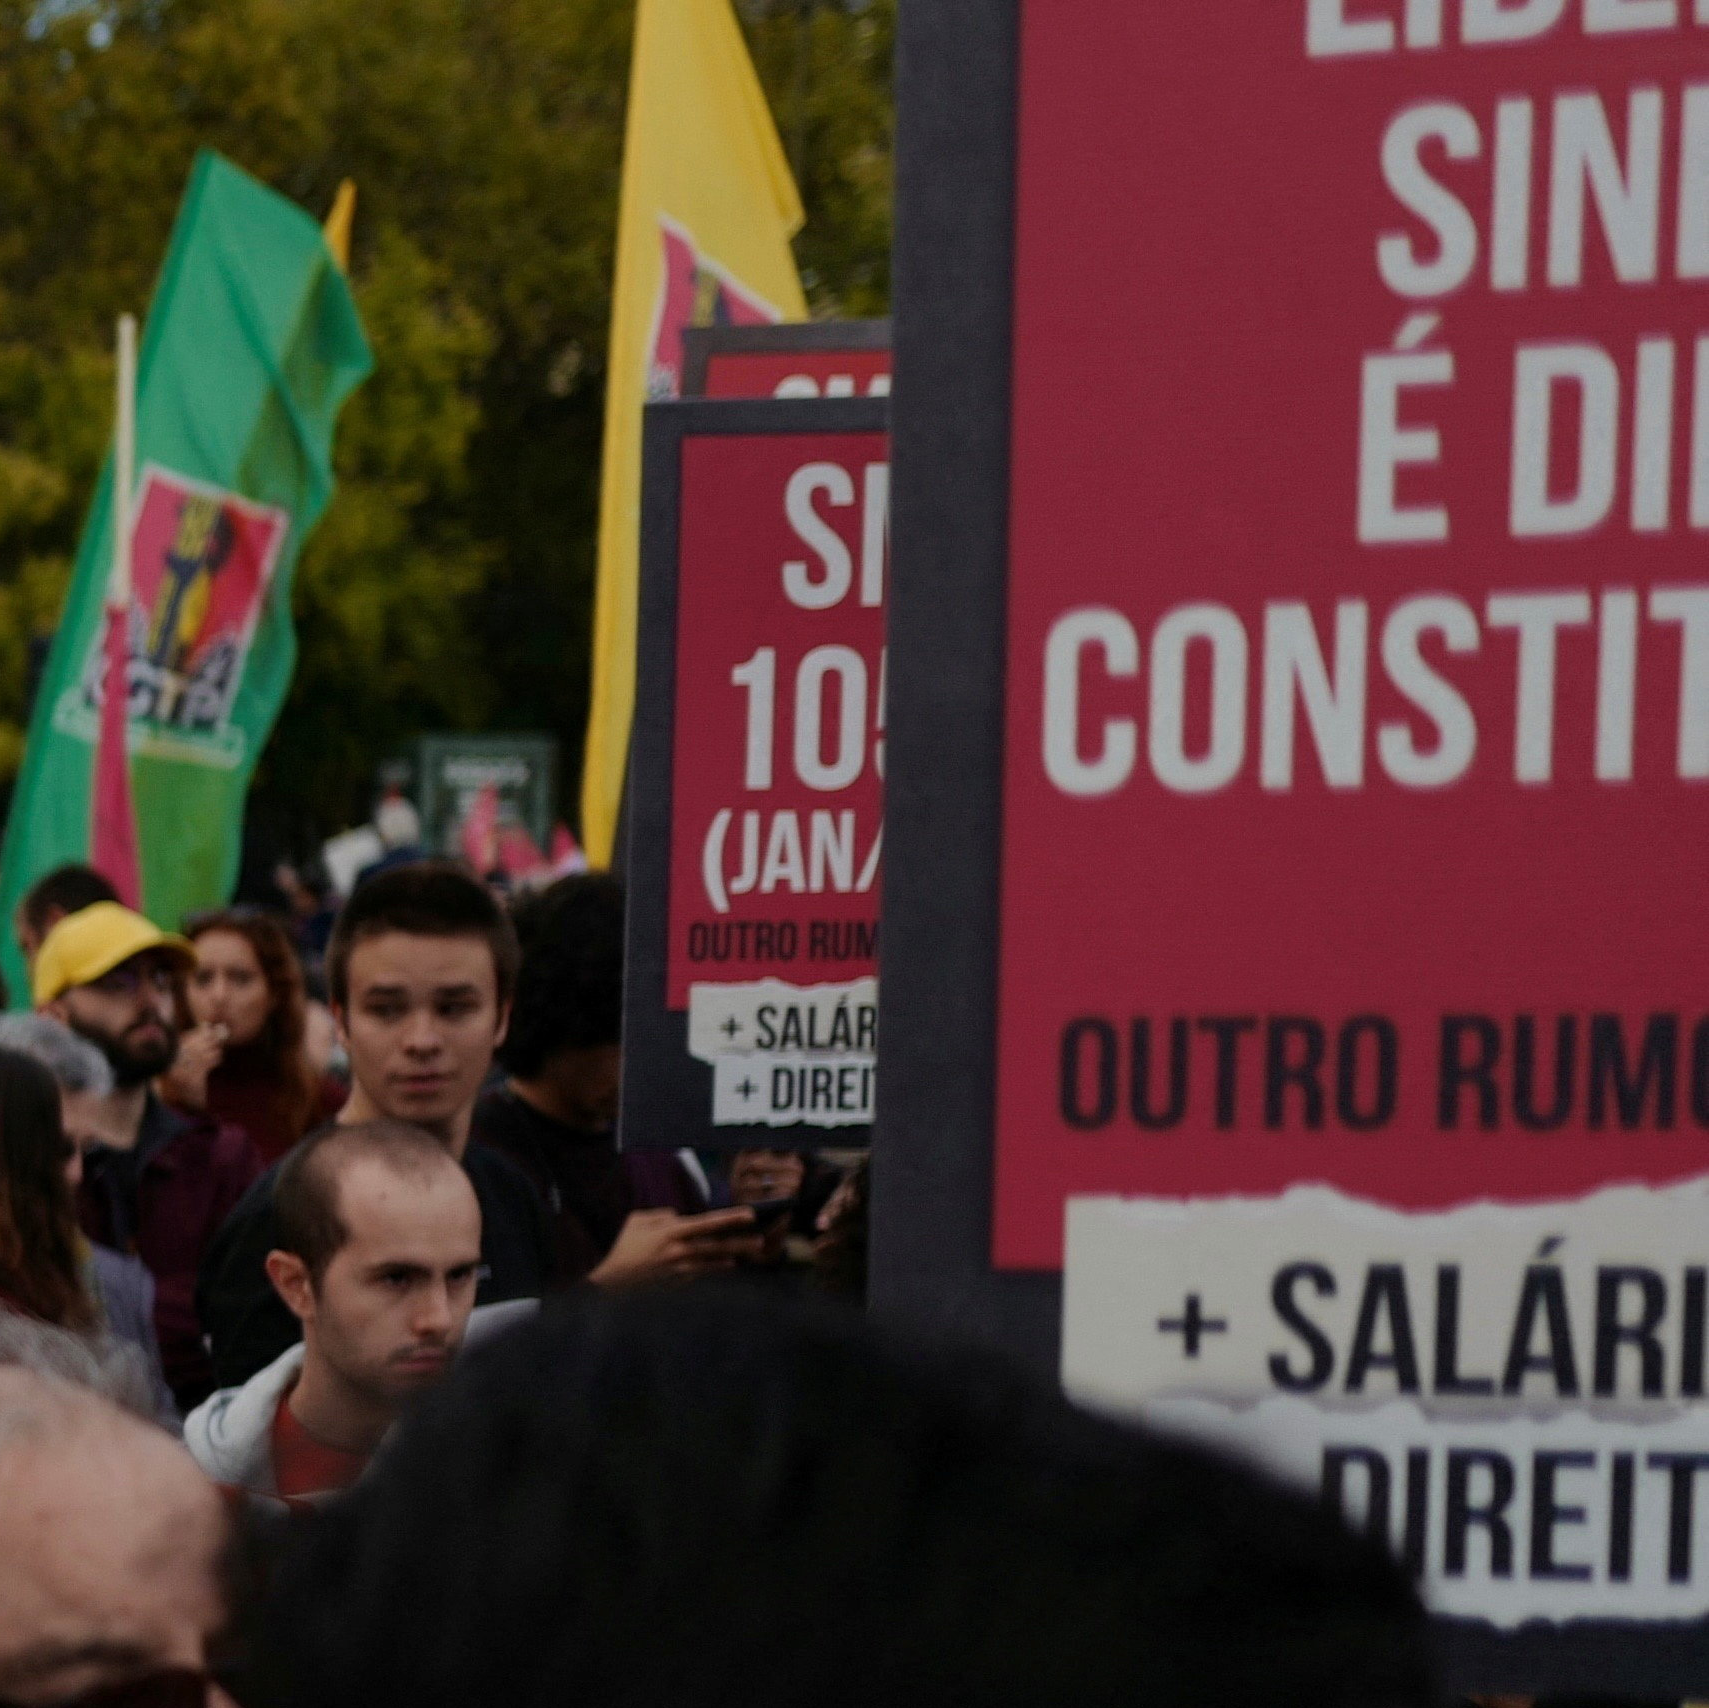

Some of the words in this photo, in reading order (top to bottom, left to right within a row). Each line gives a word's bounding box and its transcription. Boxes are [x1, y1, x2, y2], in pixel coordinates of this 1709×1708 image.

[1357, 312, 1456, 546] É
[1510, 336, 1709, 538] DI
[731, 643, 888, 791] 10
[688, 920, 798, 963] OUTRO
[770, 1065, 876, 1111] DIREI
[1057, 1014, 1400, 1133] OUTRO
[1157, 1292, 1229, 1360] +
